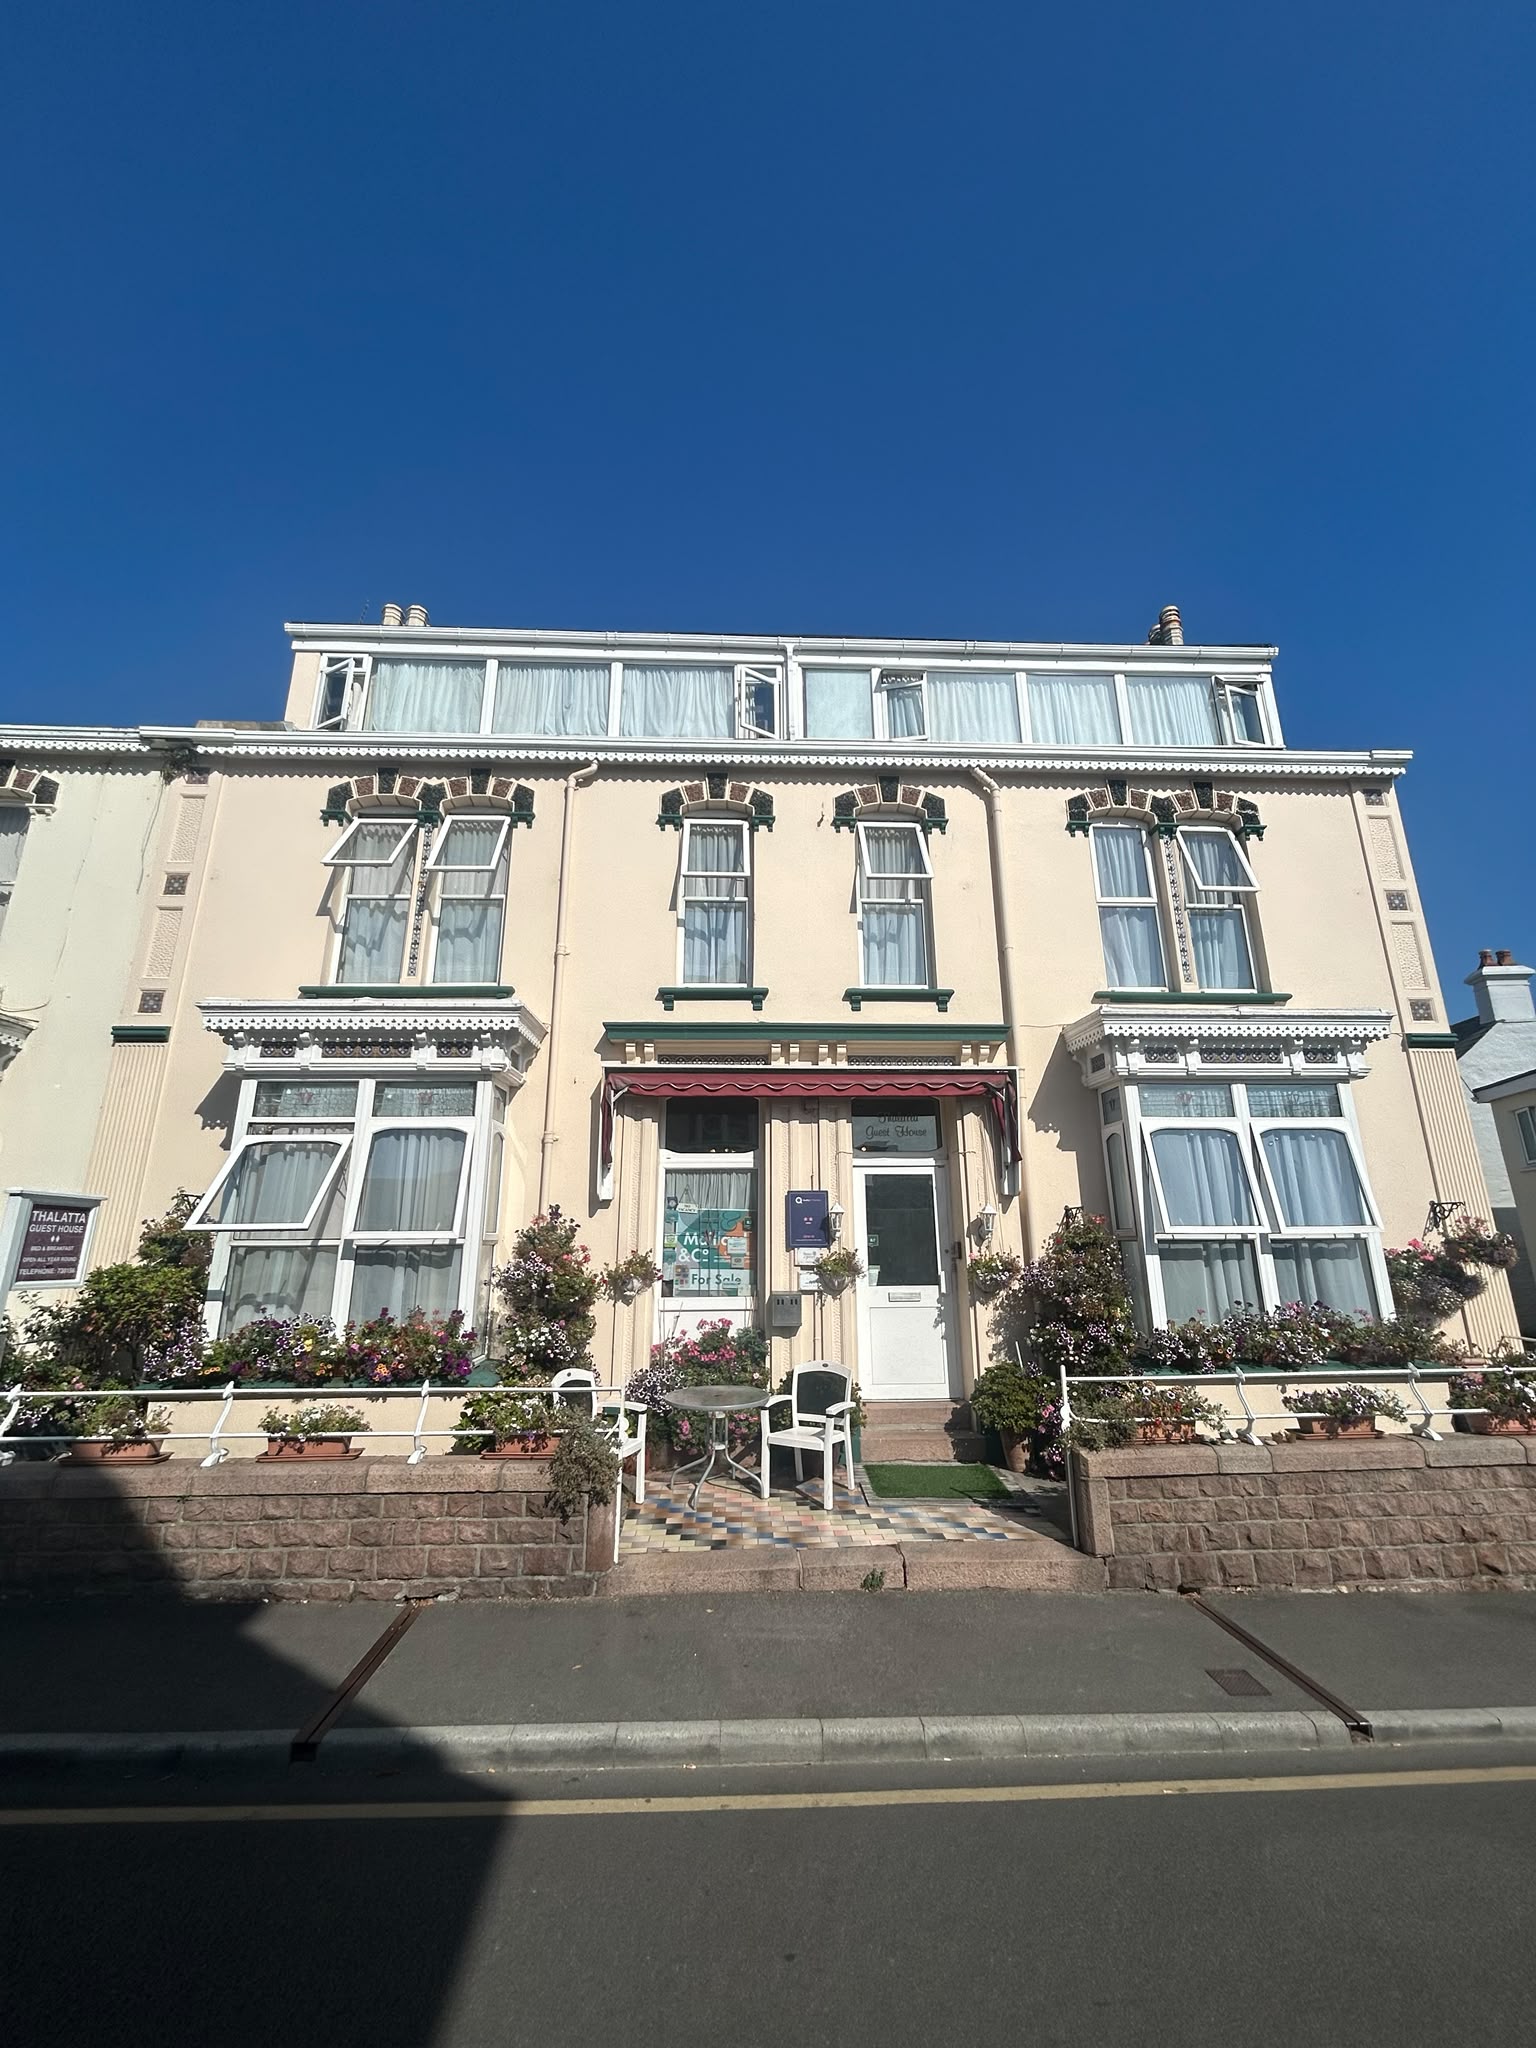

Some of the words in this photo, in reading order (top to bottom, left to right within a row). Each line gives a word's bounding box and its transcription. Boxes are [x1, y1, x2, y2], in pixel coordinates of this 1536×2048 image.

[865, 1125, 890, 1140] Guest
[894, 1125, 927, 1137] House
[32, 1211, 86, 1223] THALATTA
[29, 1224, 57, 1233] GUEST
[58, 1225, 84, 1233] HOUSE
[691, 1274, 711, 1285] For
[715, 1273, 742, 1285] Sale
